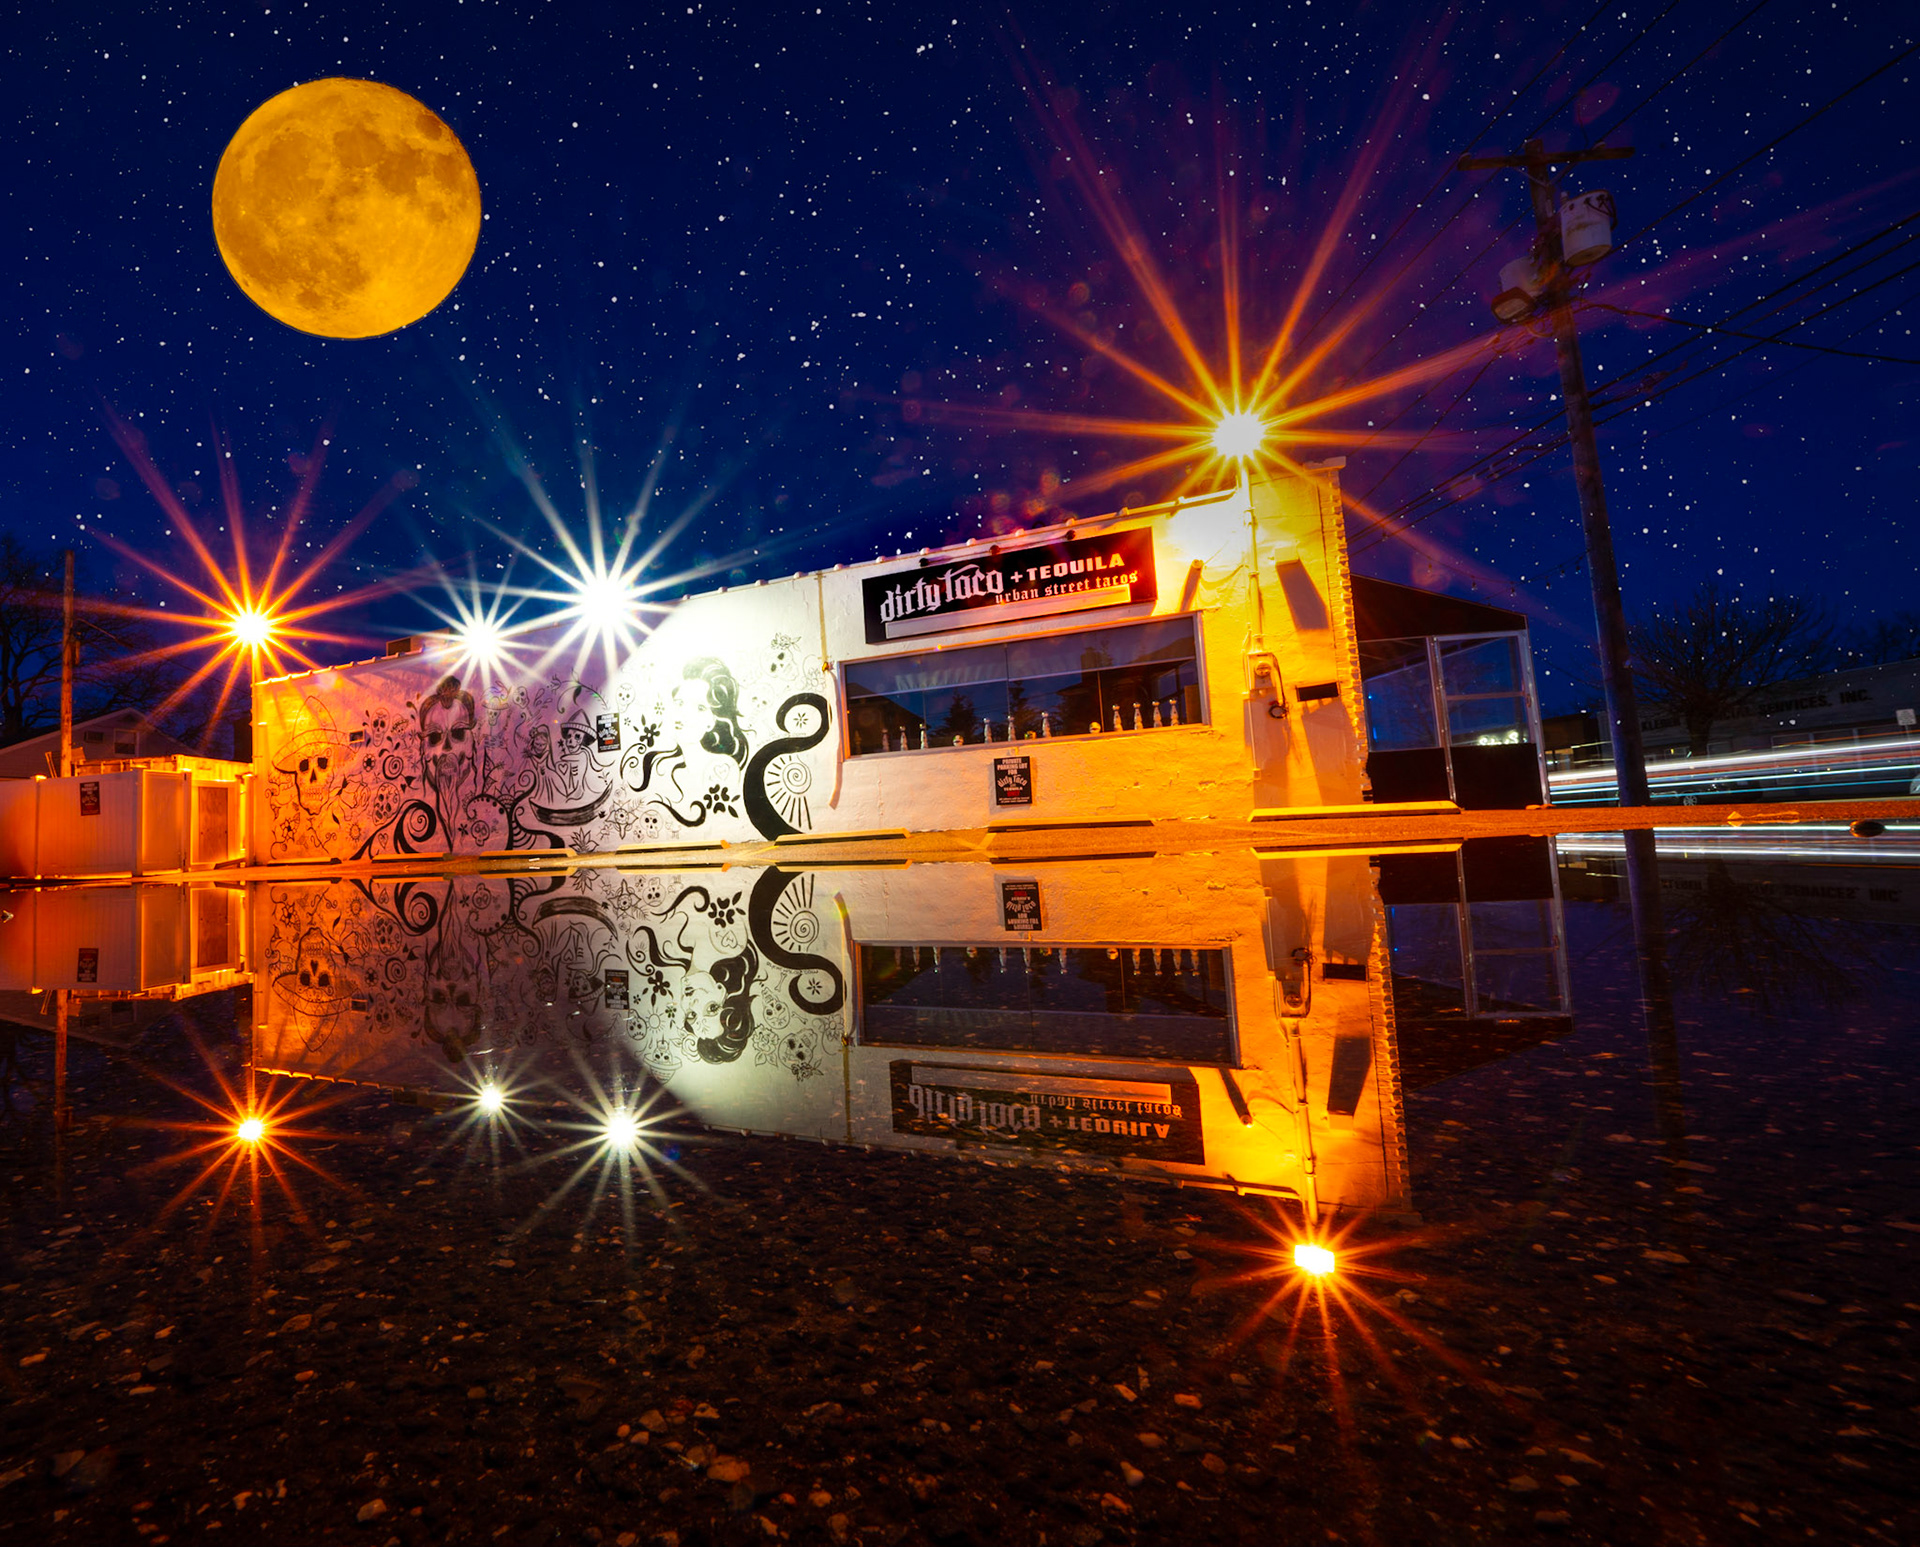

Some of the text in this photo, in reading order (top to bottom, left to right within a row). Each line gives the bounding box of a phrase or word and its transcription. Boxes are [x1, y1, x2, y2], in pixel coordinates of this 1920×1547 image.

[881, 577, 941, 623] dirty
[1027, 553, 1124, 581] TEQUILA
[996, 571, 1138, 604] urban street tacos
